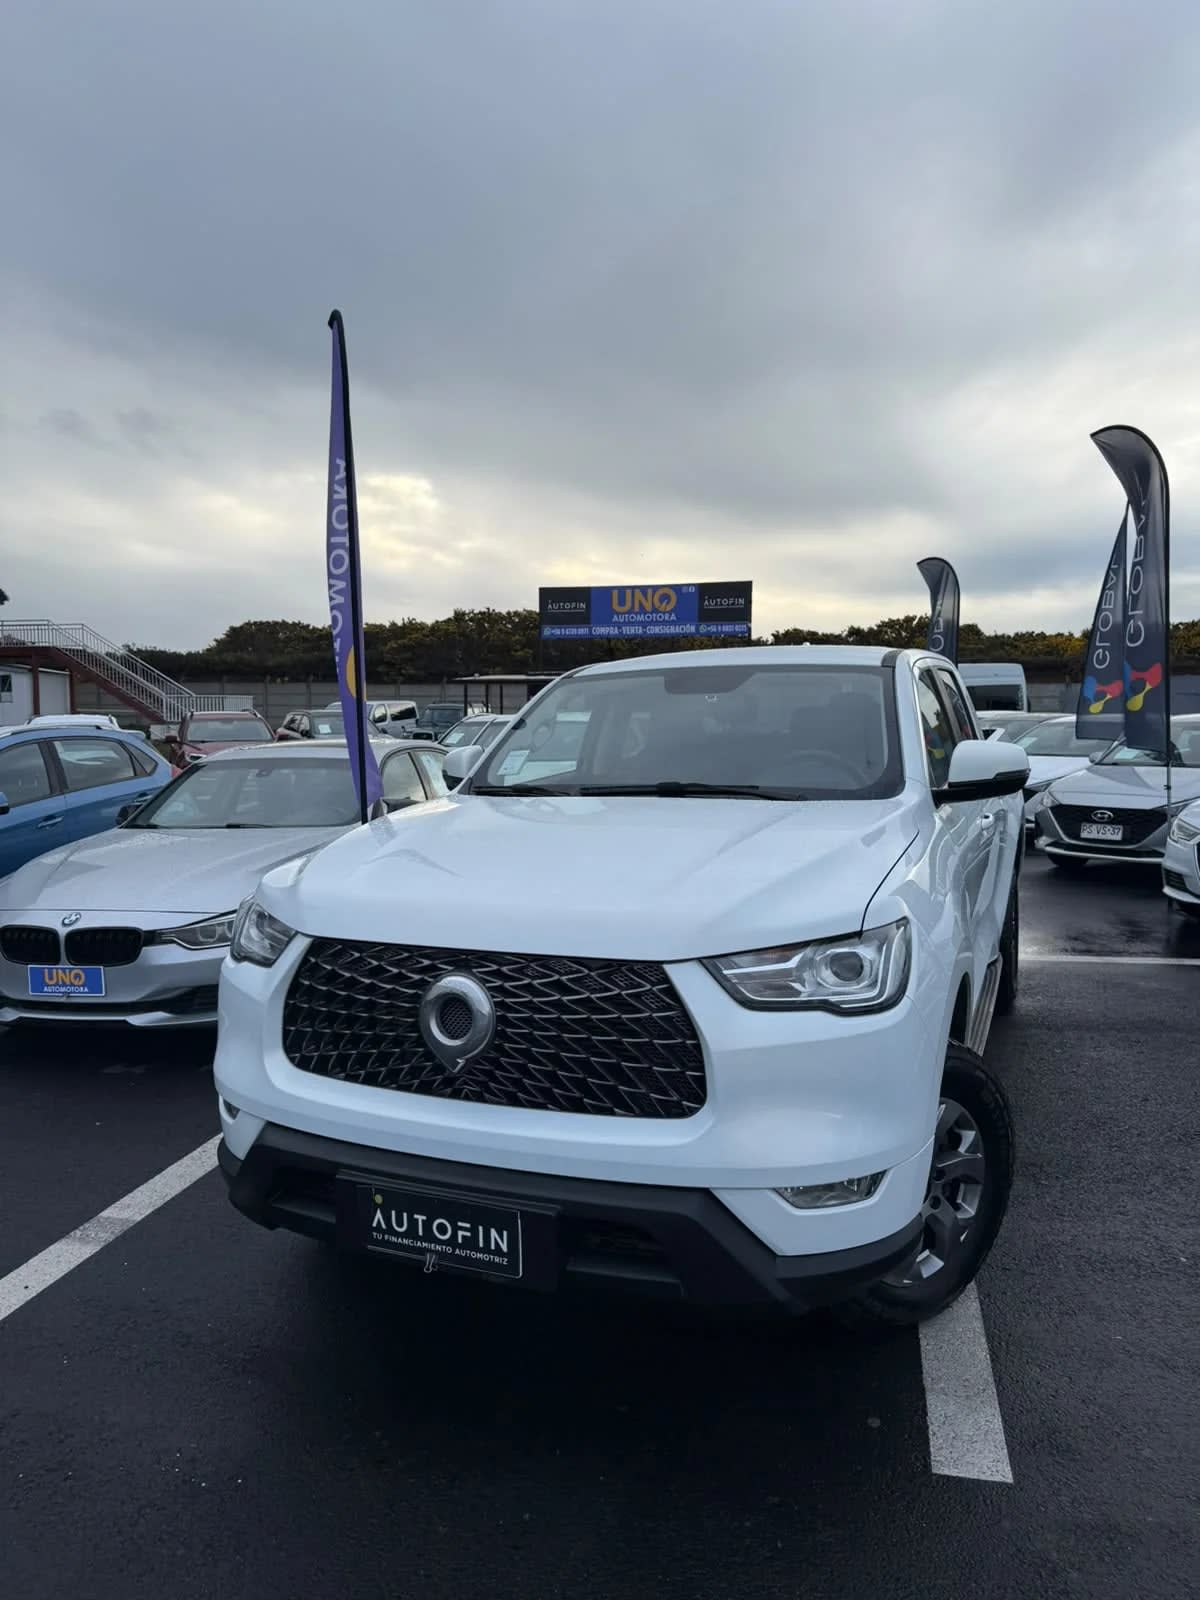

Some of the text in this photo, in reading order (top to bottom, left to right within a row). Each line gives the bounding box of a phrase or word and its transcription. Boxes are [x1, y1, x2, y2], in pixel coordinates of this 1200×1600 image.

[547, 601, 586, 610] AUTOFIN
[611, 587, 677, 613] UNO
[704, 597, 745, 606] AUTOFIN
[612, 613, 677, 623] AUTOMOTORA
[43, 968, 85, 985] UNO
[372, 1207, 508, 1254] AUTOFIN
[372, 1231, 508, 1265] TU FINANCIAMIENTO AUTOMOTRIZ
